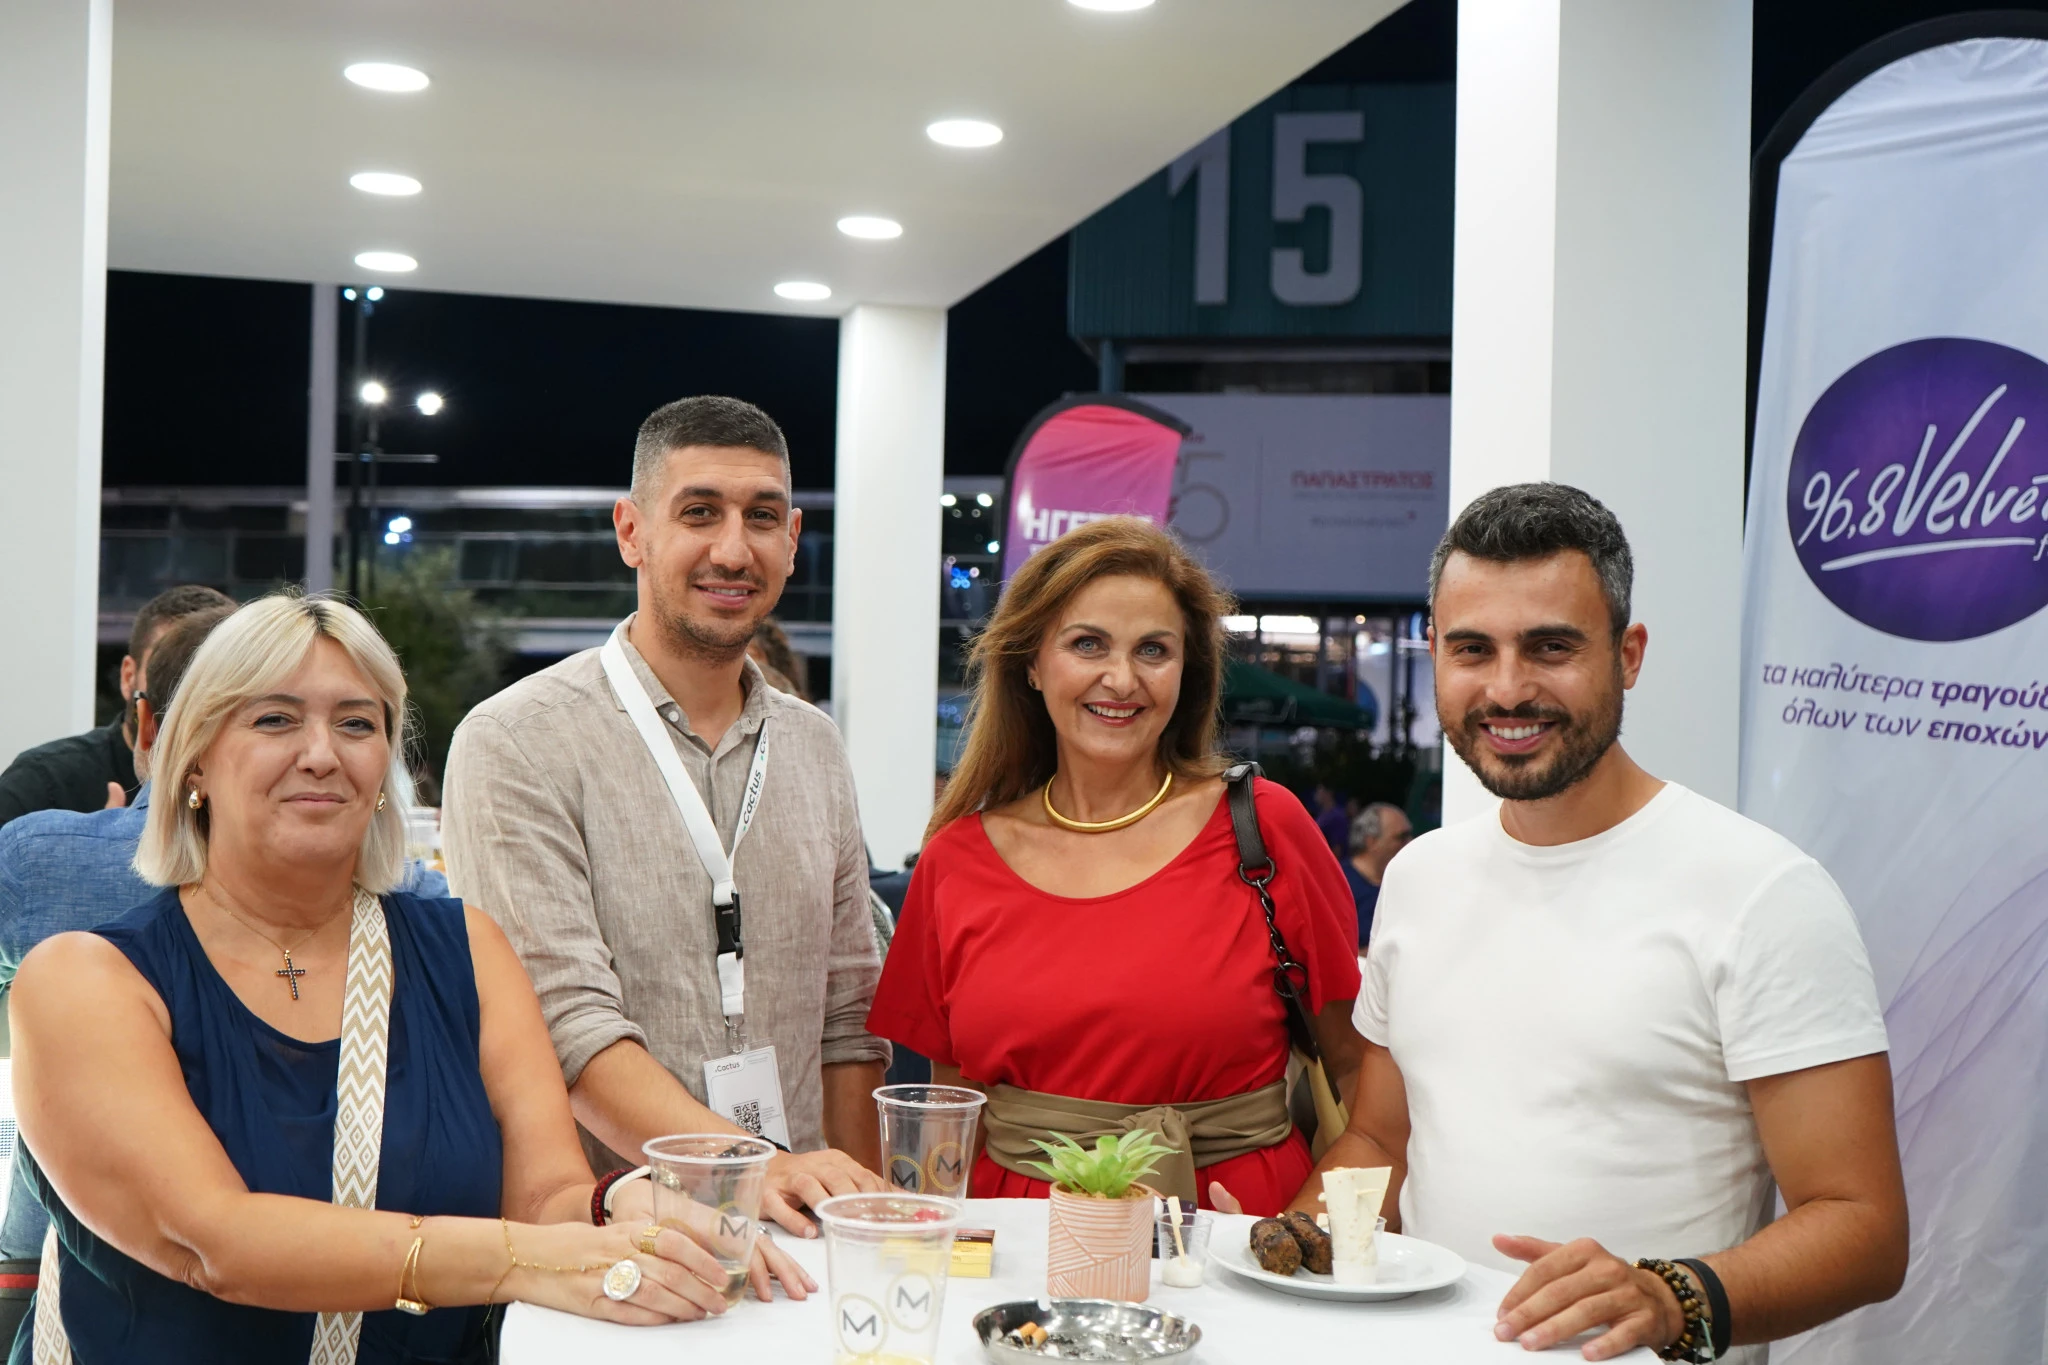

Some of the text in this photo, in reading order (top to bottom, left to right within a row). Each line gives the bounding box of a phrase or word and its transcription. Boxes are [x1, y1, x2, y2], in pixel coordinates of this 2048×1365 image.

[1166, 111, 1365, 306] 15
[1762, 664, 1787, 685] τα
[1791, 662, 1924, 703] καλύτερα
[1782, 696, 2048, 750] όλων των εποχών
[719, 1215, 749, 1240] M
[896, 1285, 930, 1313] M
[842, 1308, 877, 1337] M
